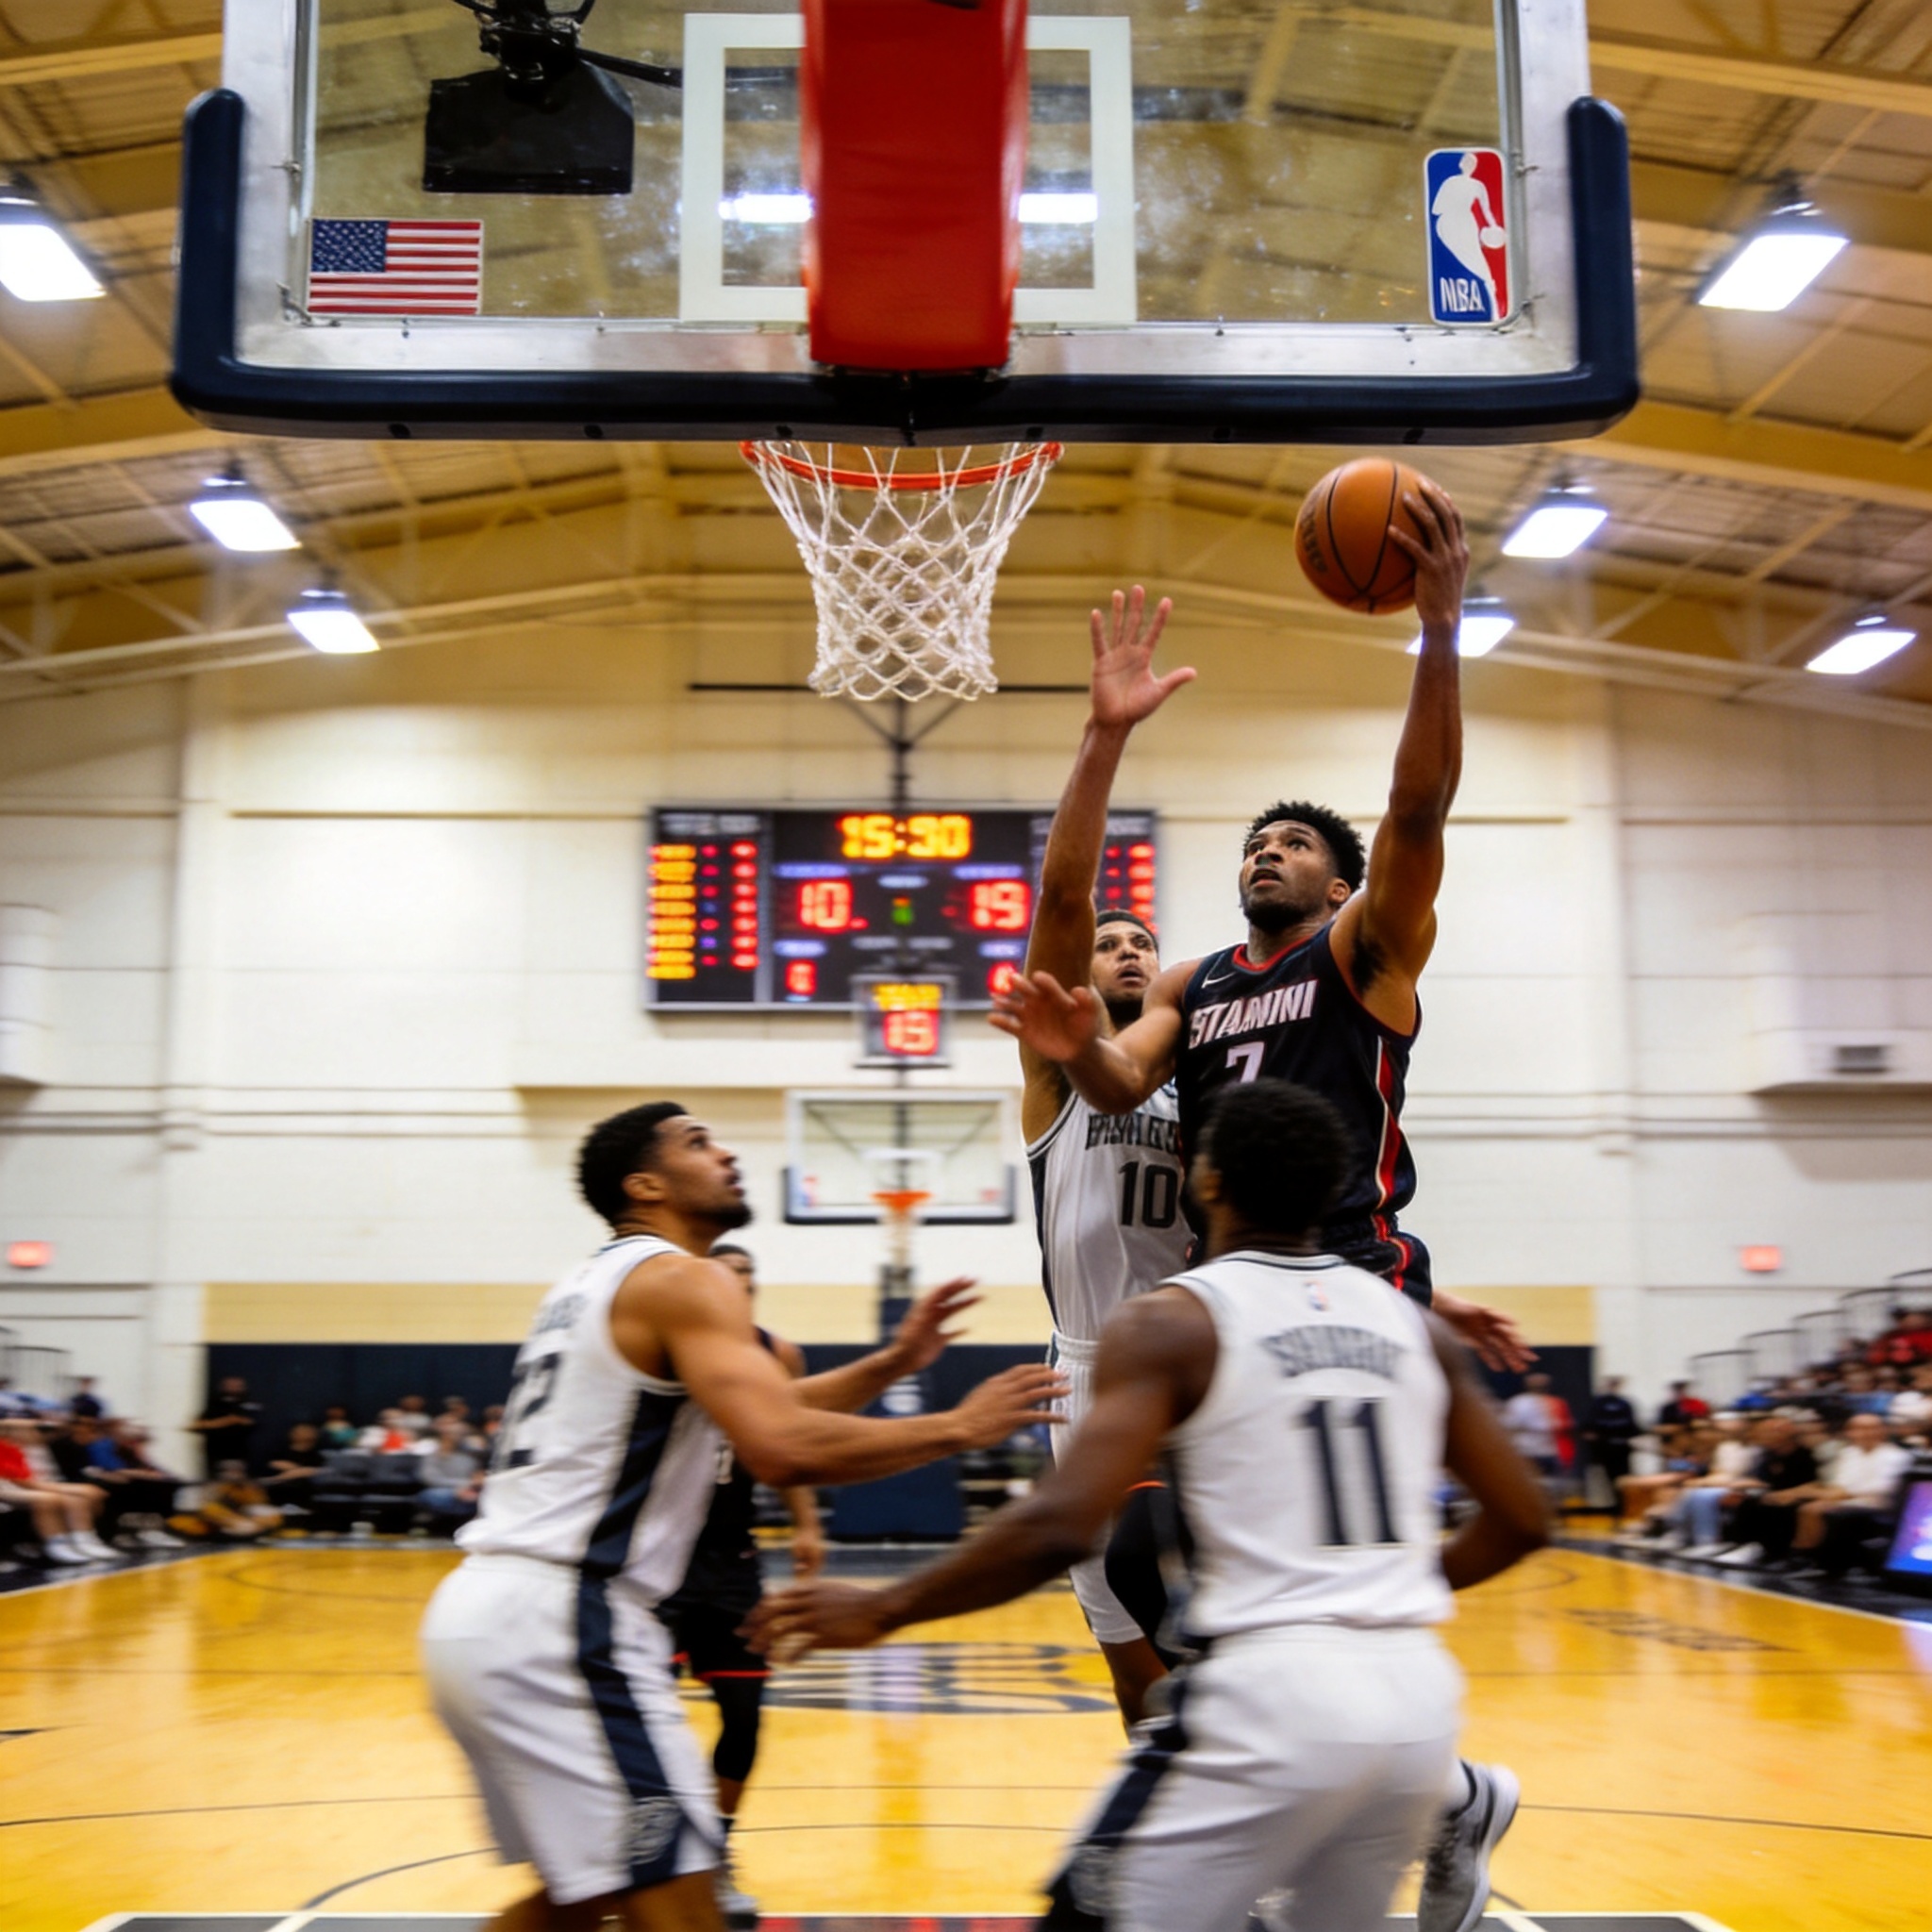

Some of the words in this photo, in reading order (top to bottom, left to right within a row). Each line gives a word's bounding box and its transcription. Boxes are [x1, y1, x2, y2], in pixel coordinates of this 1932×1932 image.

[1440, 277, 1485, 312] NBA
[841, 814, 971, 858] 15:30
[799, 880, 851, 929] 10
[973, 880, 1029, 928] 19
[1118, 1160, 1178, 1228] 10
[1292, 1400, 1404, 1545] 11
